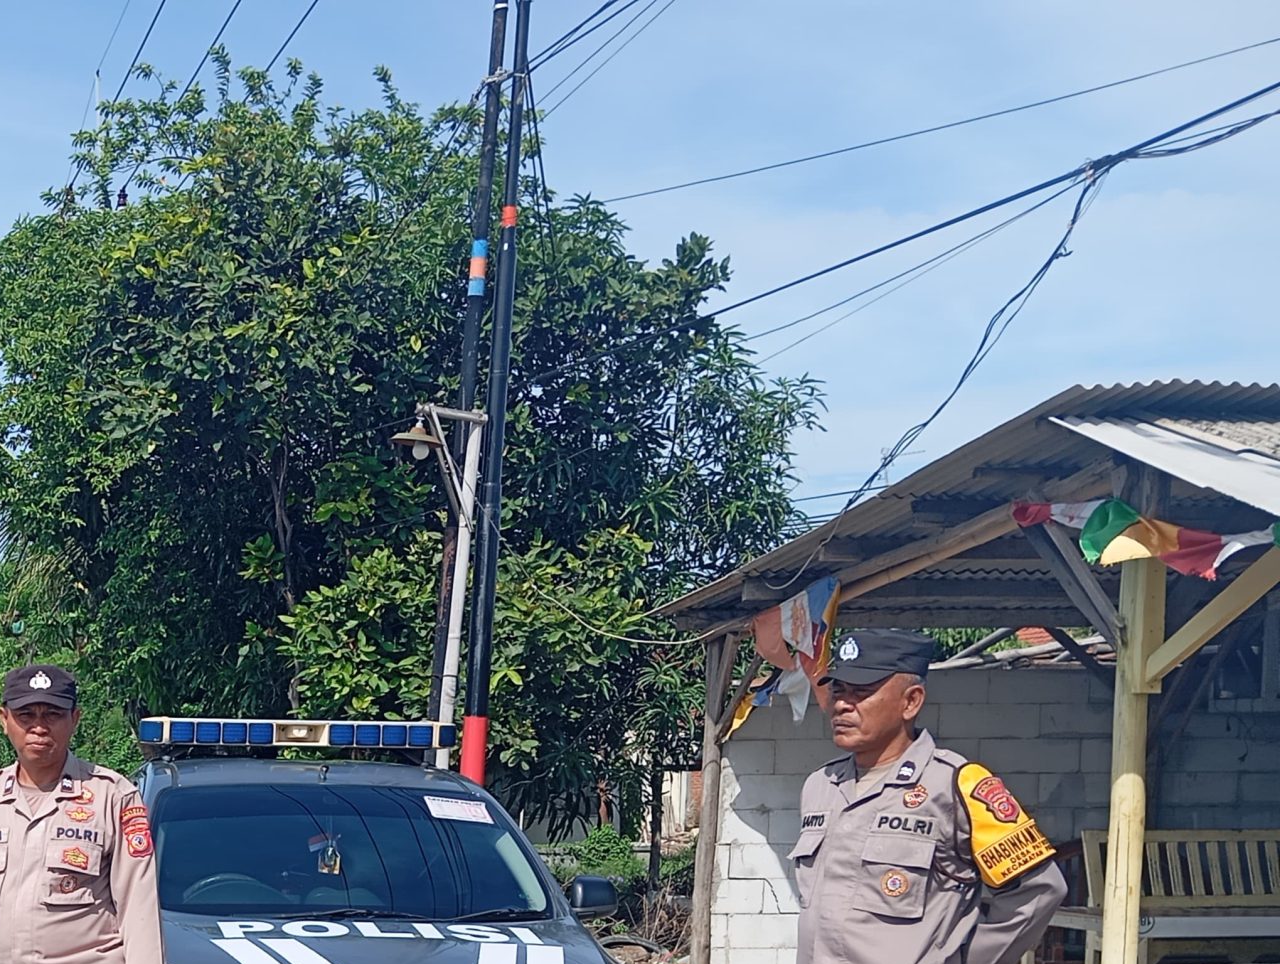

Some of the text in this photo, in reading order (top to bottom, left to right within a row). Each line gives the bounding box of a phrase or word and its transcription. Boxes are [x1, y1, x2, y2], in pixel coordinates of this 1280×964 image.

[877, 816, 933, 835] POLRI
[56, 827, 98, 842] POLRI
[1010, 849, 1031, 864] DESA
[216, 920, 544, 945] POLISI
